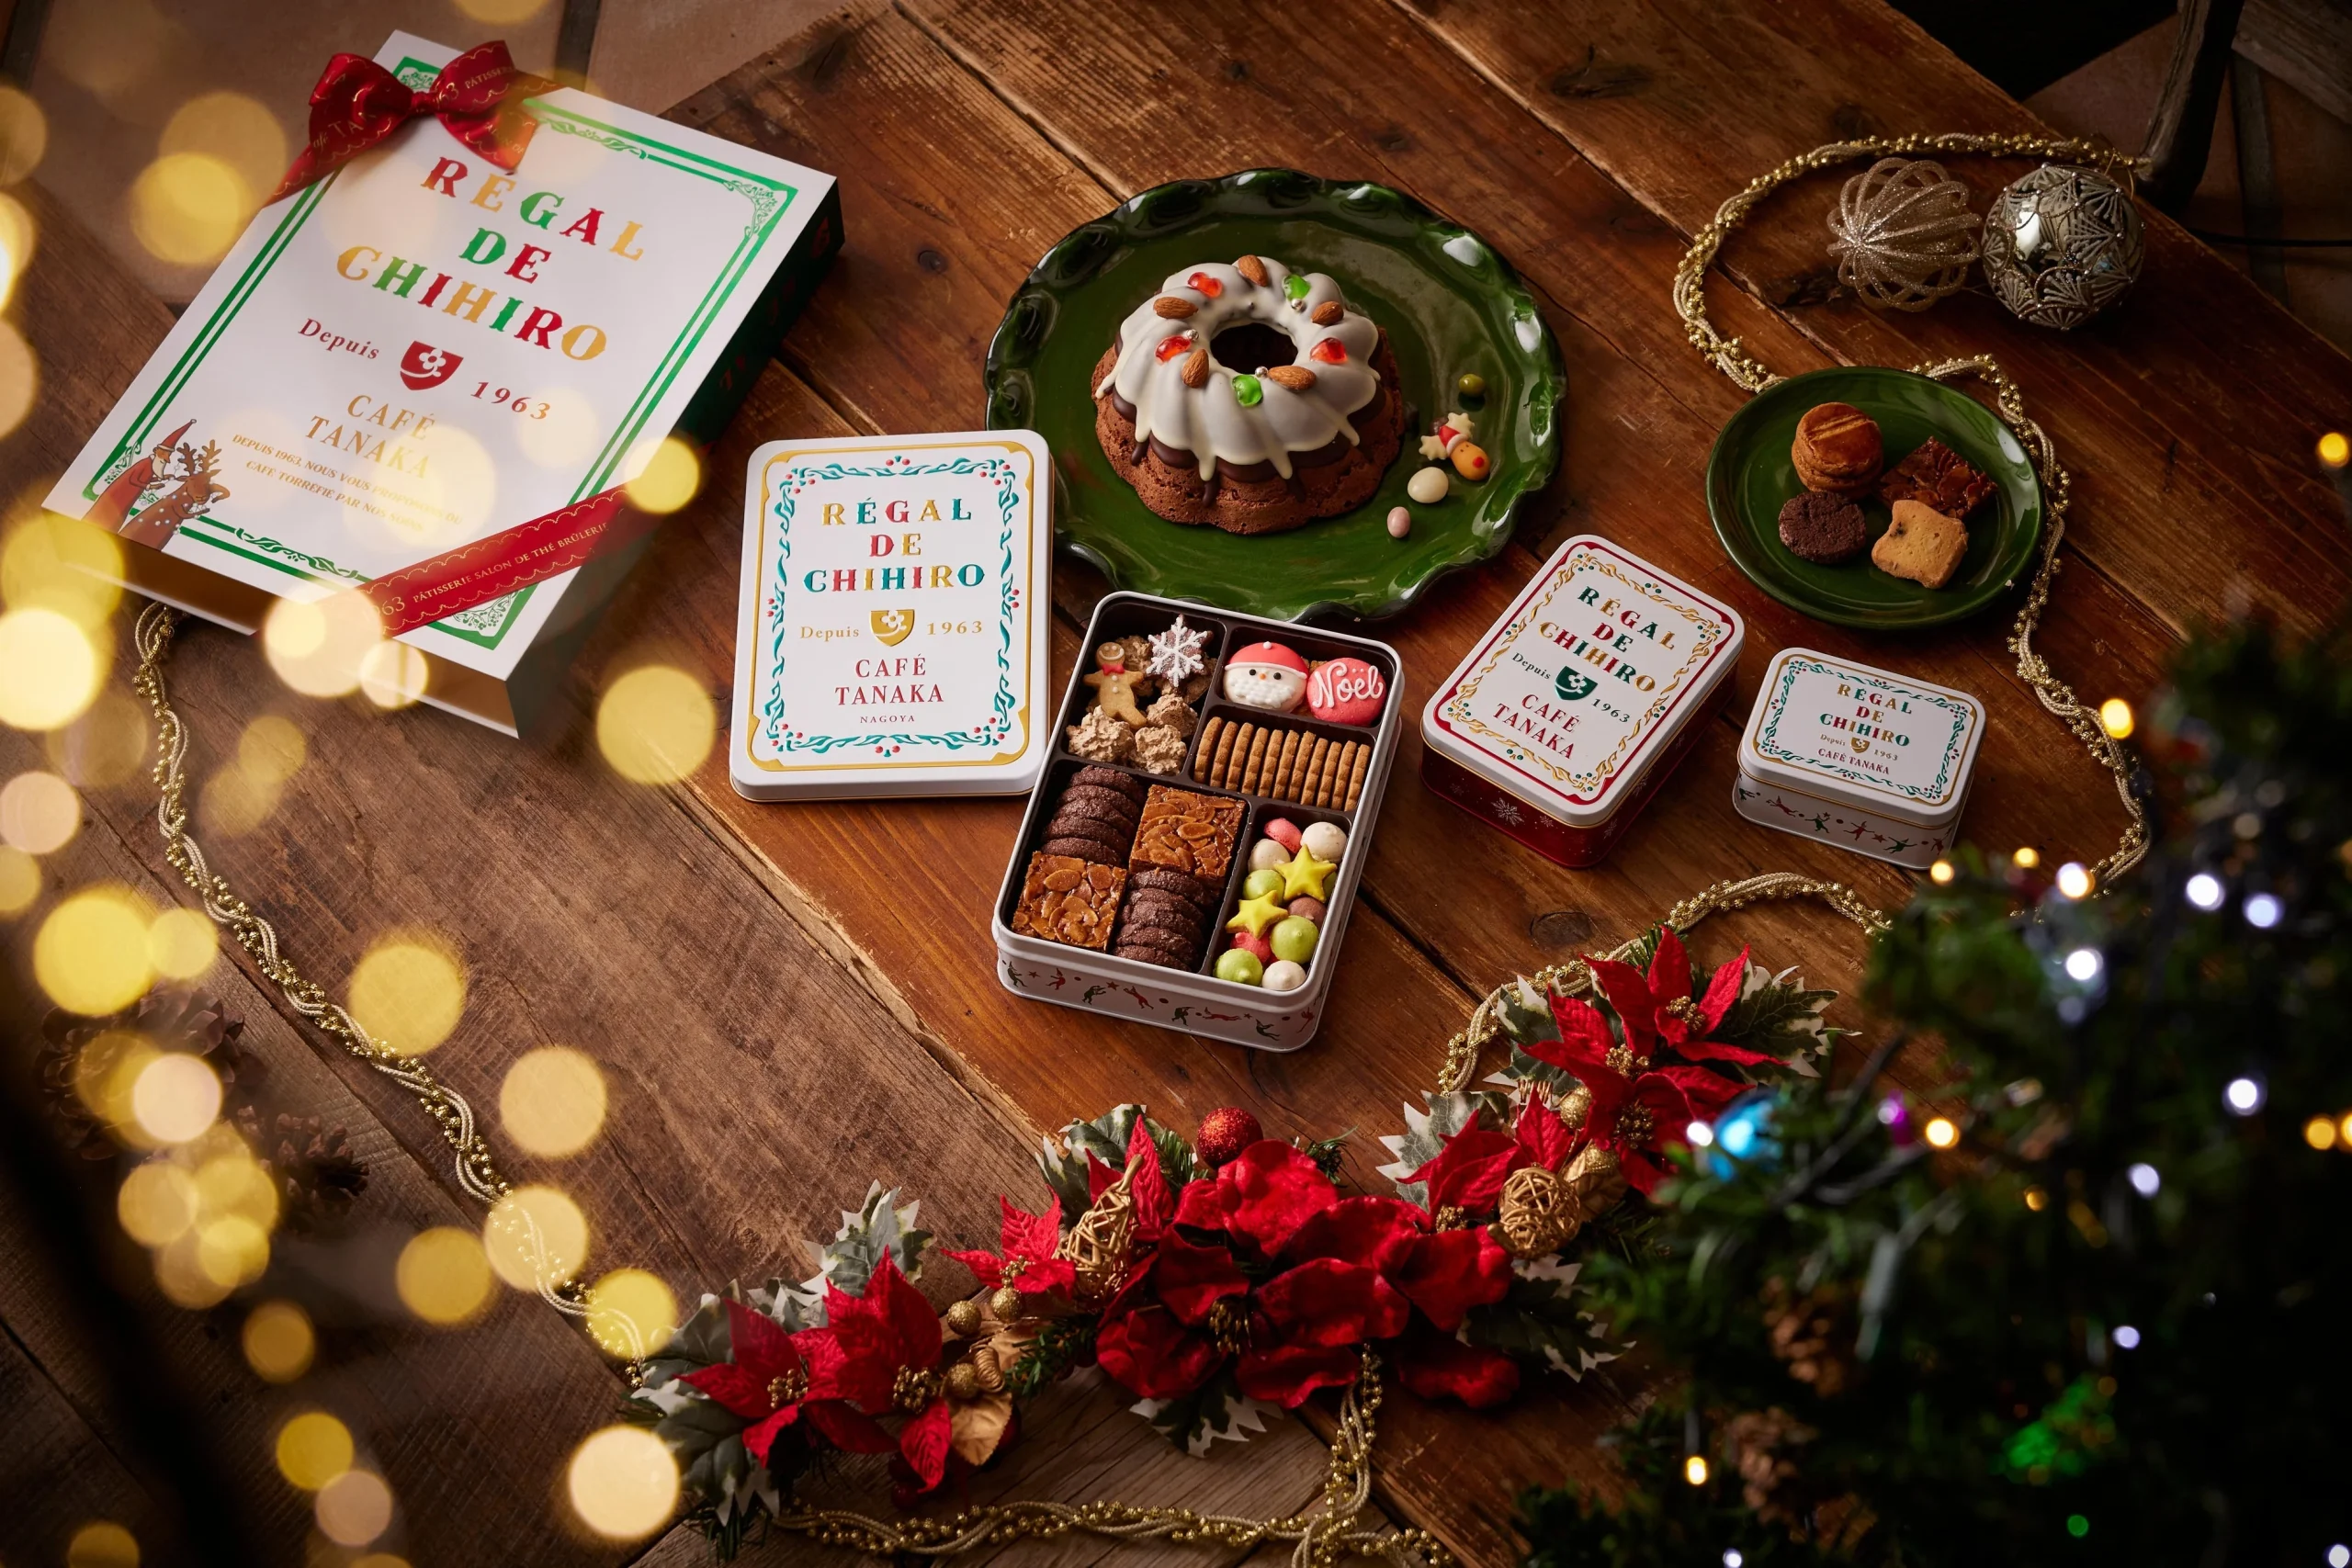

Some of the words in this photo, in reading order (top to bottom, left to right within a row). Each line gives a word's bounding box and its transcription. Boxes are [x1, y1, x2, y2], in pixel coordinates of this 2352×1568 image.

[458, 227, 551, 284] DE
[336, 245, 607, 361] CHIHIRO
[298, 318, 379, 359] Depuis
[470, 381, 550, 420] 1963
[347, 395, 435, 441] CAFÉ
[232, 434, 274, 456] DEPUIS
[305, 460, 337, 479] NOUS
[340, 472, 371, 491] VOUS
[305, 415, 429, 479] TANAKA
[335, 492, 361, 508] PAR
[362, 502, 387, 518] NOS
[821, 497, 972, 525] RÉGAL
[868, 533, 922, 558] DE
[413, 575, 473, 604] PÂTISSERIE
[474, 559, 514, 580] SALON
[514, 553, 531, 565] DE
[531, 543, 556, 558] THÉ
[803, 563, 986, 592] CHIHIRO
[800, 626, 860, 642] Depuis
[927, 620, 983, 636] 1963
[1577, 586, 1676, 650] RÉGAL
[1591, 622, 1634, 653] DE
[855, 653, 927, 678] CAFÉ
[1538, 621, 1656, 692] CHIHIRO
[834, 683, 944, 705] TANAKA
[1312, 661, 1384, 708] Noël
[1511, 652, 1551, 680] Depuis
[1591, 698, 1631, 723] 1963
[860, 715, 915, 724] NAGOYA
[1492, 703, 1575, 760] TANAKA
[1521, 694, 1580, 734] CAFÉ
[1819, 713, 1910, 747] CHIHIRO
[1856, 705, 1884, 724] DE
[1818, 748, 1847, 762] CAFÉ
[1849, 756, 1890, 775] TANAKA
[1819, 733, 1846, 747] Depuis
[1873, 749, 1898, 761] 1963
